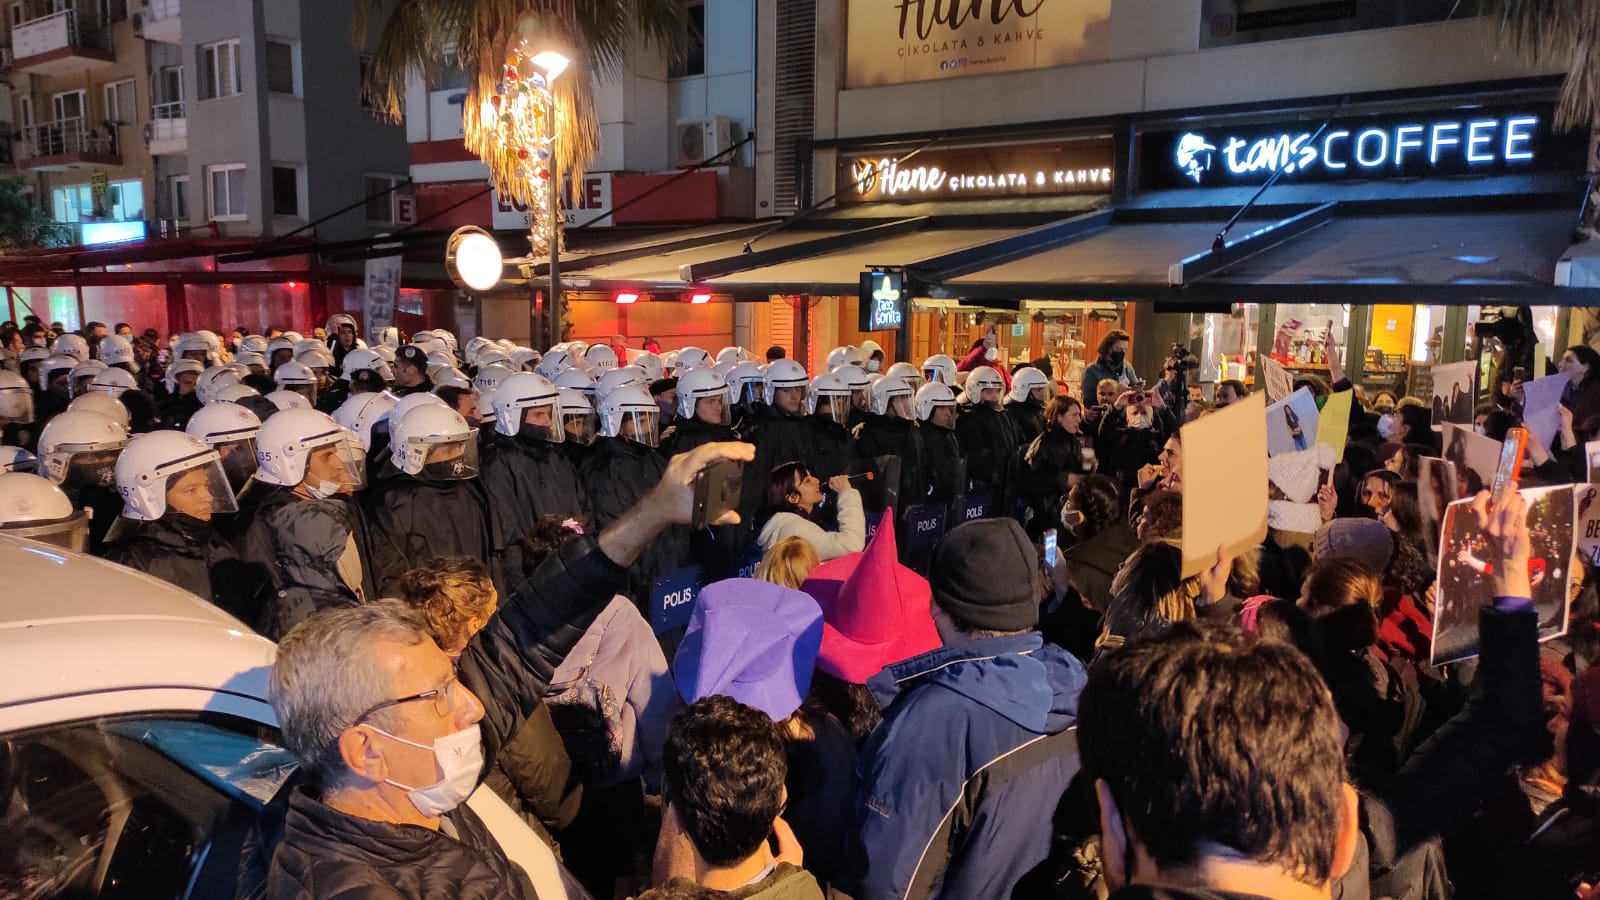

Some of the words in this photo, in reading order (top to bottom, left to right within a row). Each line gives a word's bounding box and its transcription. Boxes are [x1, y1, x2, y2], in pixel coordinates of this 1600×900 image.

[976, 36, 985, 47] &
[993, 29, 1044, 45] KAHVE
[1222, 133, 1317, 173] tans
[1322, 116, 1538, 169] COFFEE
[879, 158, 947, 195] Hane
[949, 173, 1027, 191] ÇİKOLATA
[1036, 171, 1045, 185] &
[1055, 168, 1112, 184] KAHVE
[399, 200, 411, 222] E
[258, 451, 272, 462] 35
